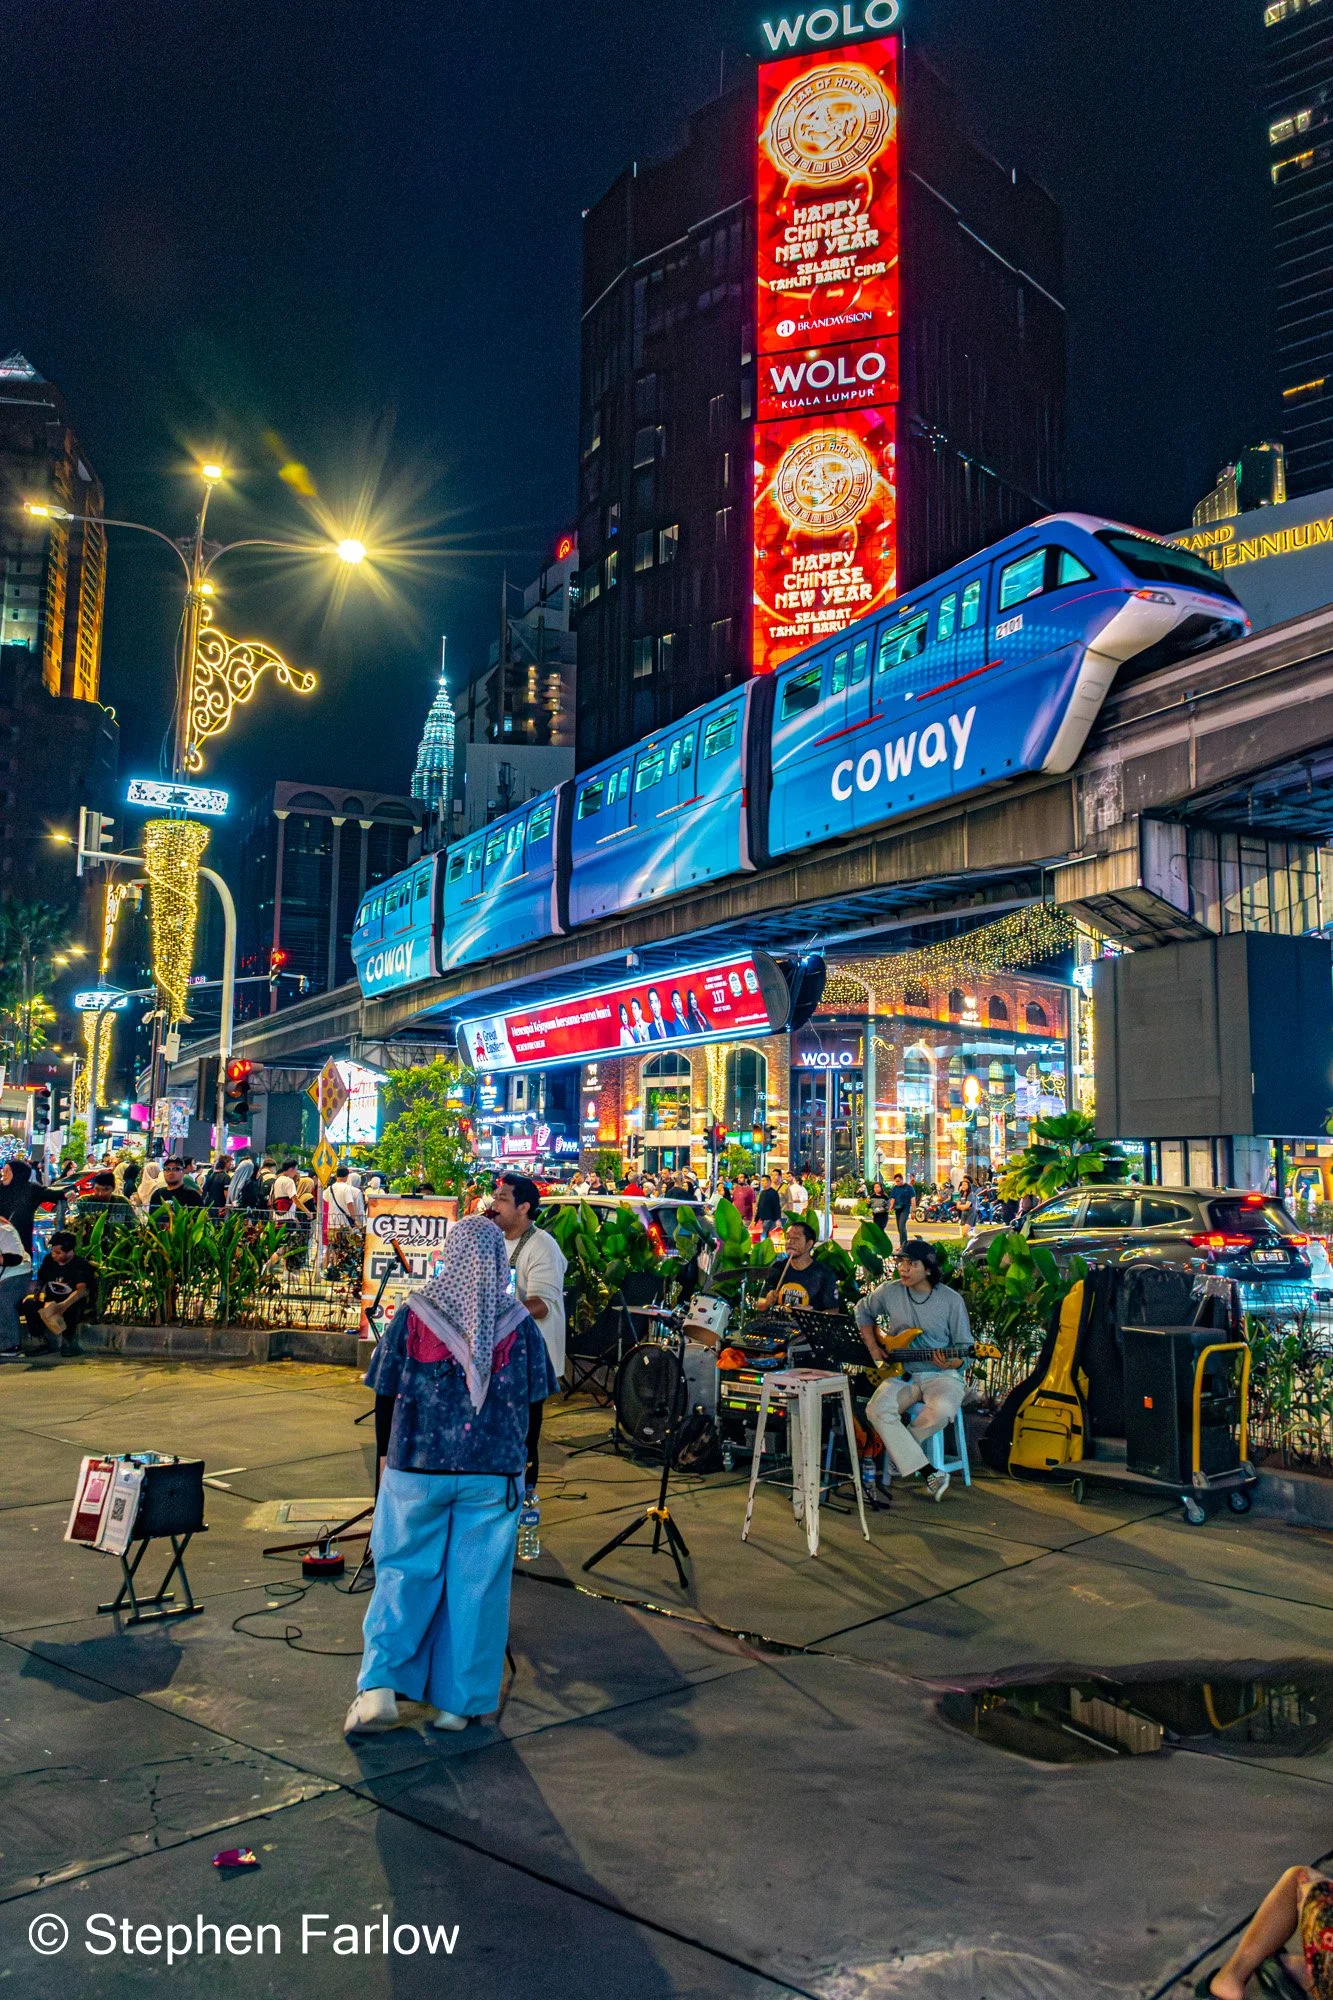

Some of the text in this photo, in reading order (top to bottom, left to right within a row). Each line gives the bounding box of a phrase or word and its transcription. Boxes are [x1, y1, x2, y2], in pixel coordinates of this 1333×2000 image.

[763, 0, 899, 50] WOLO
[815, 78, 832, 90] OF
[835, 77, 871, 98] HORSE
[794, 198, 860, 225] HAPPY
[784, 213, 870, 243] CHINESE
[775, 229, 879, 263] NEW YEAR
[769, 262, 886, 291] TAHUN BARU CINA
[797, 255, 857, 275] SELAMAT
[798, 311, 873, 331] BRANDAVISION
[770, 352, 886, 394] WOLO
[781, 389, 875, 409] KUALA LUMPUR
[813, 443, 826, 453] OF
[828, 442, 858, 462] HORSE
[1173, 526, 1234, 551] RAND
[1200, 517, 1333, 570] LENNIUM
[792, 550, 855, 573] HAPPY
[783, 567, 864, 590] CHINESE
[775, 584, 873, 609] NEW YEAR
[795, 608, 852, 623] SELAMAT
[996, 615, 1022, 639] 2101
[769, 624, 809, 638] TAHUN
[812, 621, 846, 634] BARU
[831, 706, 977, 801] coway
[366, 939, 415, 983] coway
[712, 989, 725, 1004] 117
[483, 1029, 497, 1041] Great
[485, 1042, 506, 1053] Eastern
[801, 1052, 853, 1066] WOLO
[373, 1214, 448, 1240] GENJI
[383, 1231, 443, 1246] Buskers
